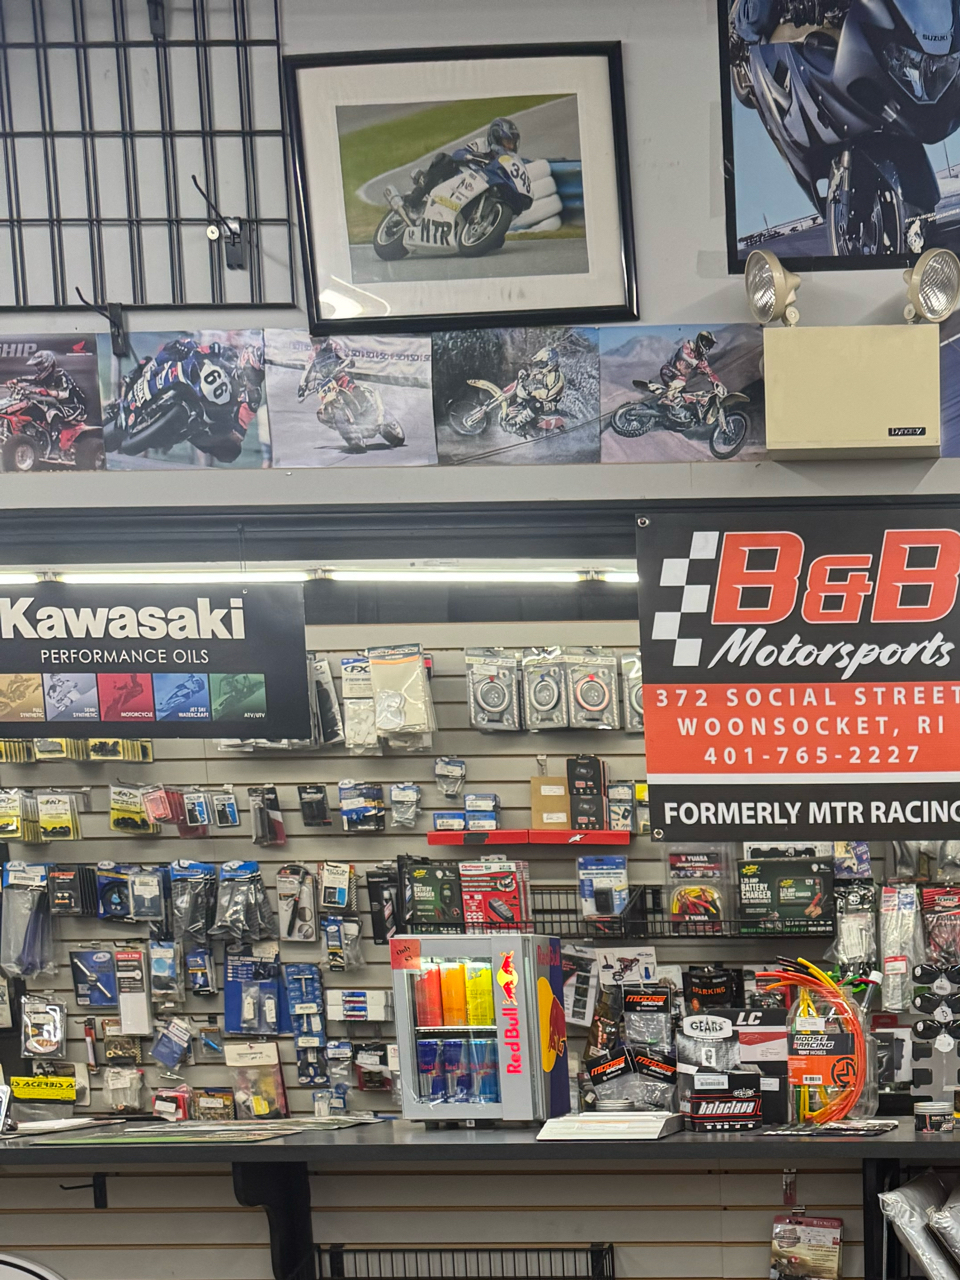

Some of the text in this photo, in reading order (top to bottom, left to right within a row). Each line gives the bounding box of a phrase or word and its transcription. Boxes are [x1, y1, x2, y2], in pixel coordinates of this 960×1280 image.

[921, 34, 948, 42] SUZUKI
[420, 218, 453, 246] MTR
[202, 370, 229, 400] 66
[0, 597, 246, 639] Kawasaki
[41, 650, 209, 663] PERFORMANCE OILS
[707, 628, 955, 680] Motorsports
[656, 689, 708, 707] 372
[727, 688, 836, 707] SOCIAL
[677, 716, 945, 737] WOONSOCKET, RI
[704, 745, 920, 765] 401-765-2227
[664, 801, 801, 825] FORMERLY
[809, 801, 865, 824] MTR
[741, 883, 768, 891] BATTERY
[741, 891, 771, 899] CHARGER
[691, 1018, 725, 1033] GEARS
[736, 1012, 763, 1025] LC
[502, 1008, 523, 1074] Bull Red
[699, 1101, 755, 1115] balaclava
